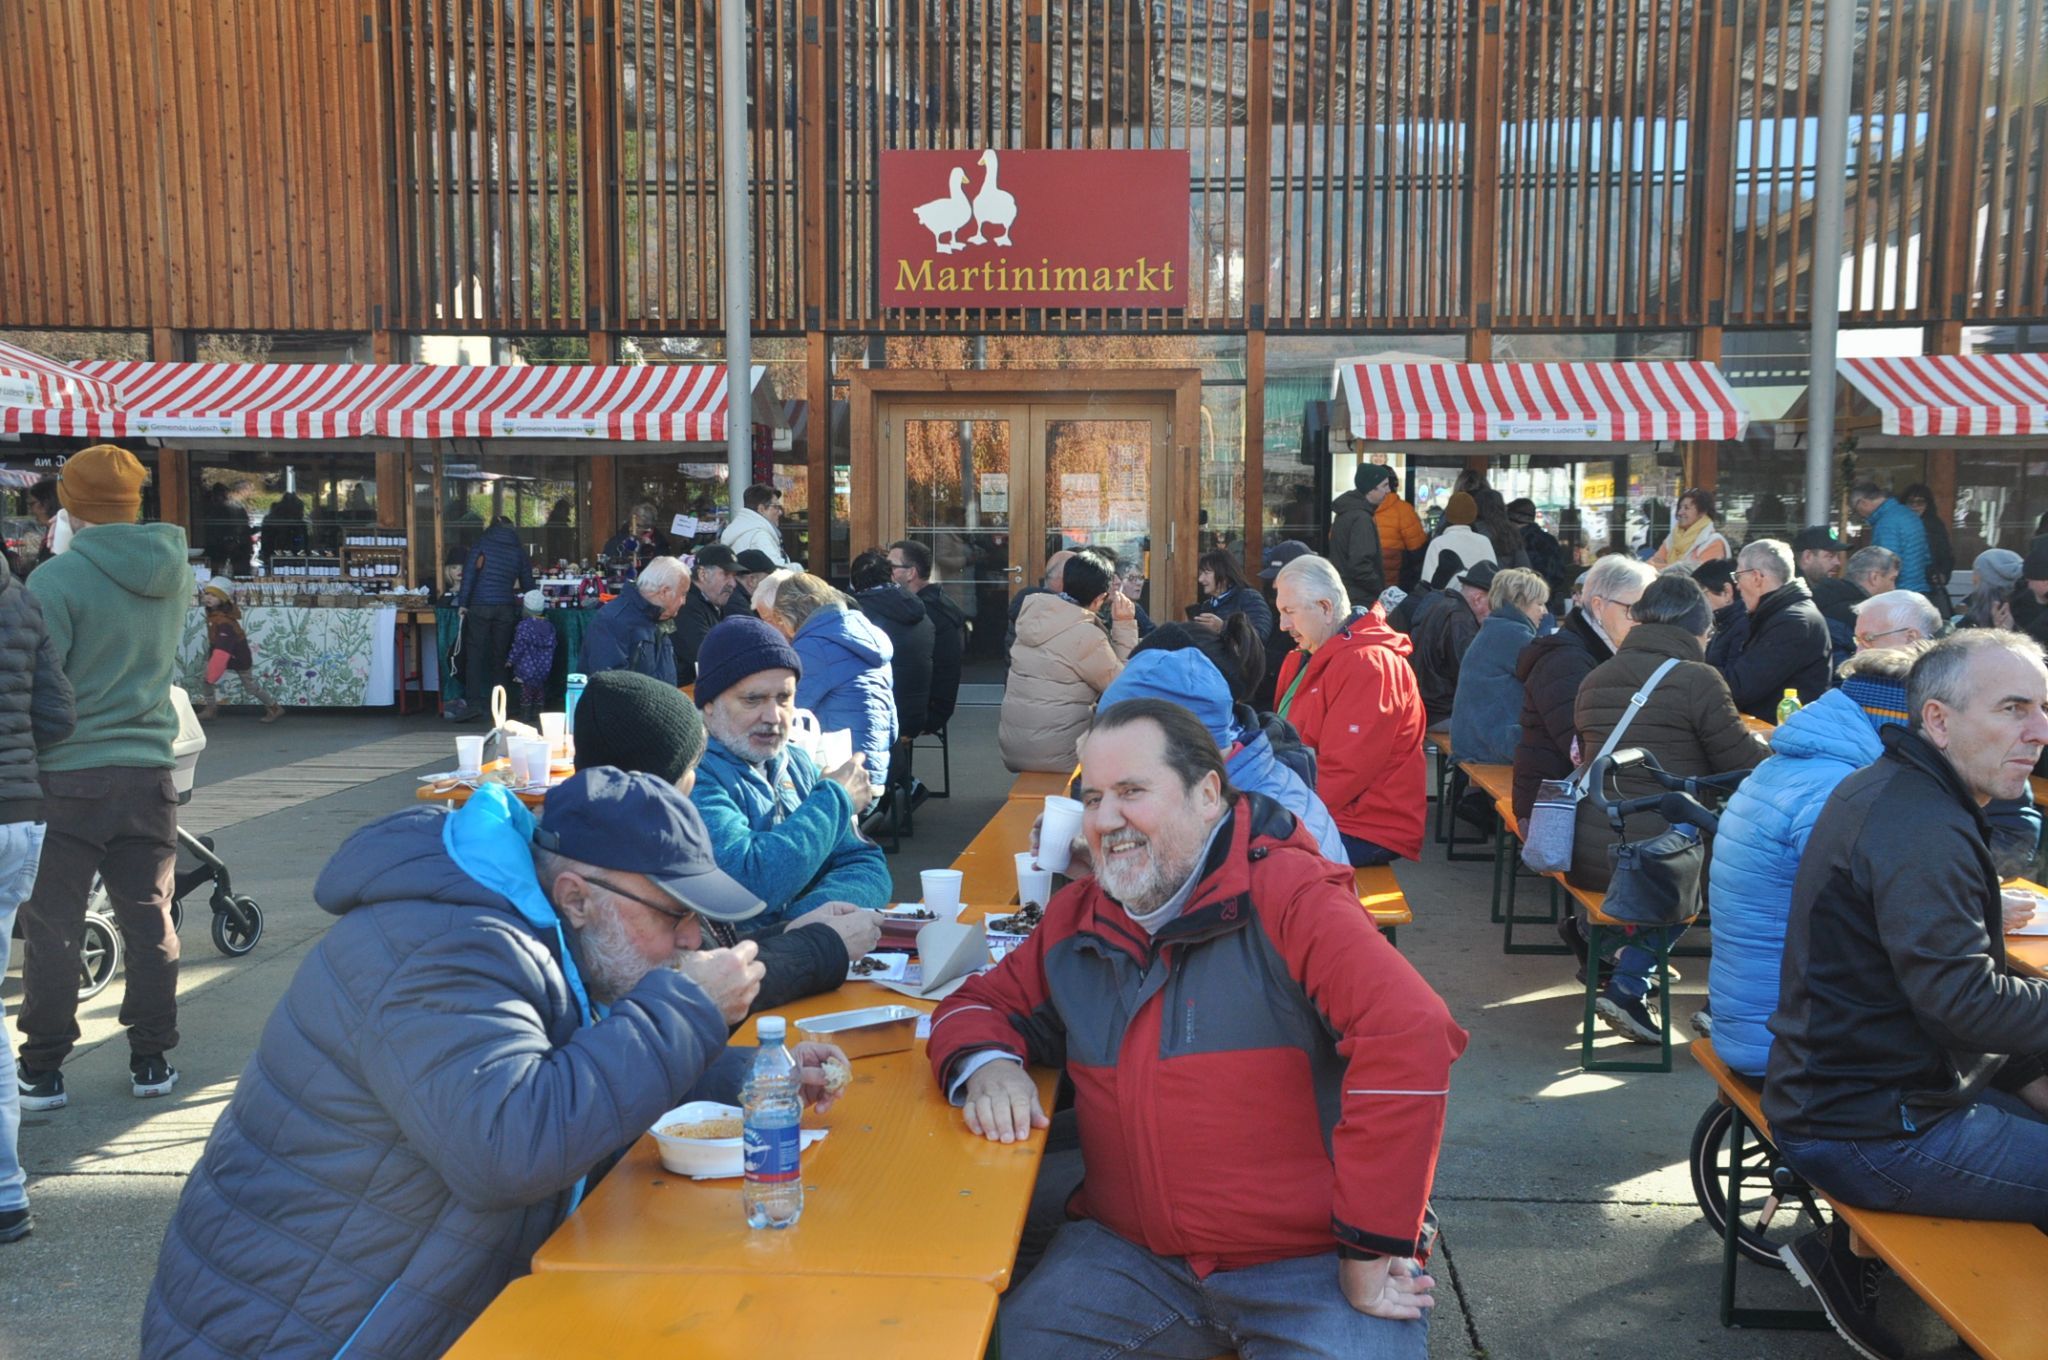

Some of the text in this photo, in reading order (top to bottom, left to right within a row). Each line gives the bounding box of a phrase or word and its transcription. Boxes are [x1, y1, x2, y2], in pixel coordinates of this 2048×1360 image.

[894, 257, 1175, 292] Martinimarkt
[150, 423, 219, 432] Gemeinde Ludesch
[1512, 426, 1584, 434] Gemeinde Ludesch
[34, 457, 52, 467] am
